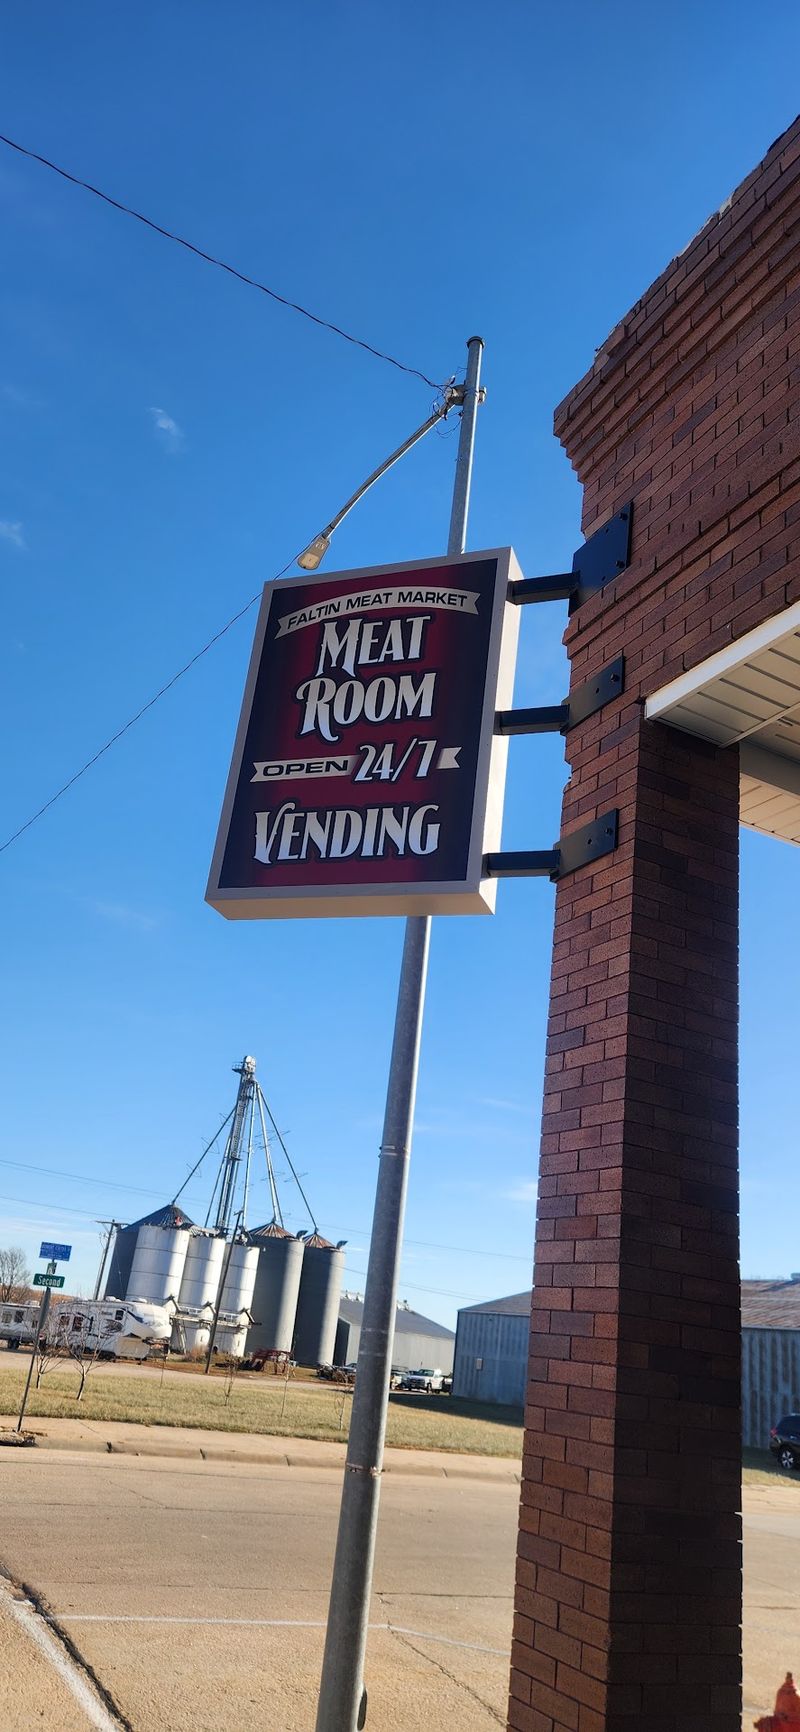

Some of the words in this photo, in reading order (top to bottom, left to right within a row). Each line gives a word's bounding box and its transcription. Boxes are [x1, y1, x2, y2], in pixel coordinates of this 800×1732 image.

[287, 601, 341, 629] FALTIN
[346, 592, 393, 609] MEAT
[397, 591, 468, 608] MARKET
[316, 615, 431, 677] MEAT
[296, 672, 437, 742] ROOM
[262, 759, 349, 777] OPEN
[354, 738, 438, 782] 24/7
[253, 802, 441, 864] VENDING
[38, 1276, 61, 1287] Second
